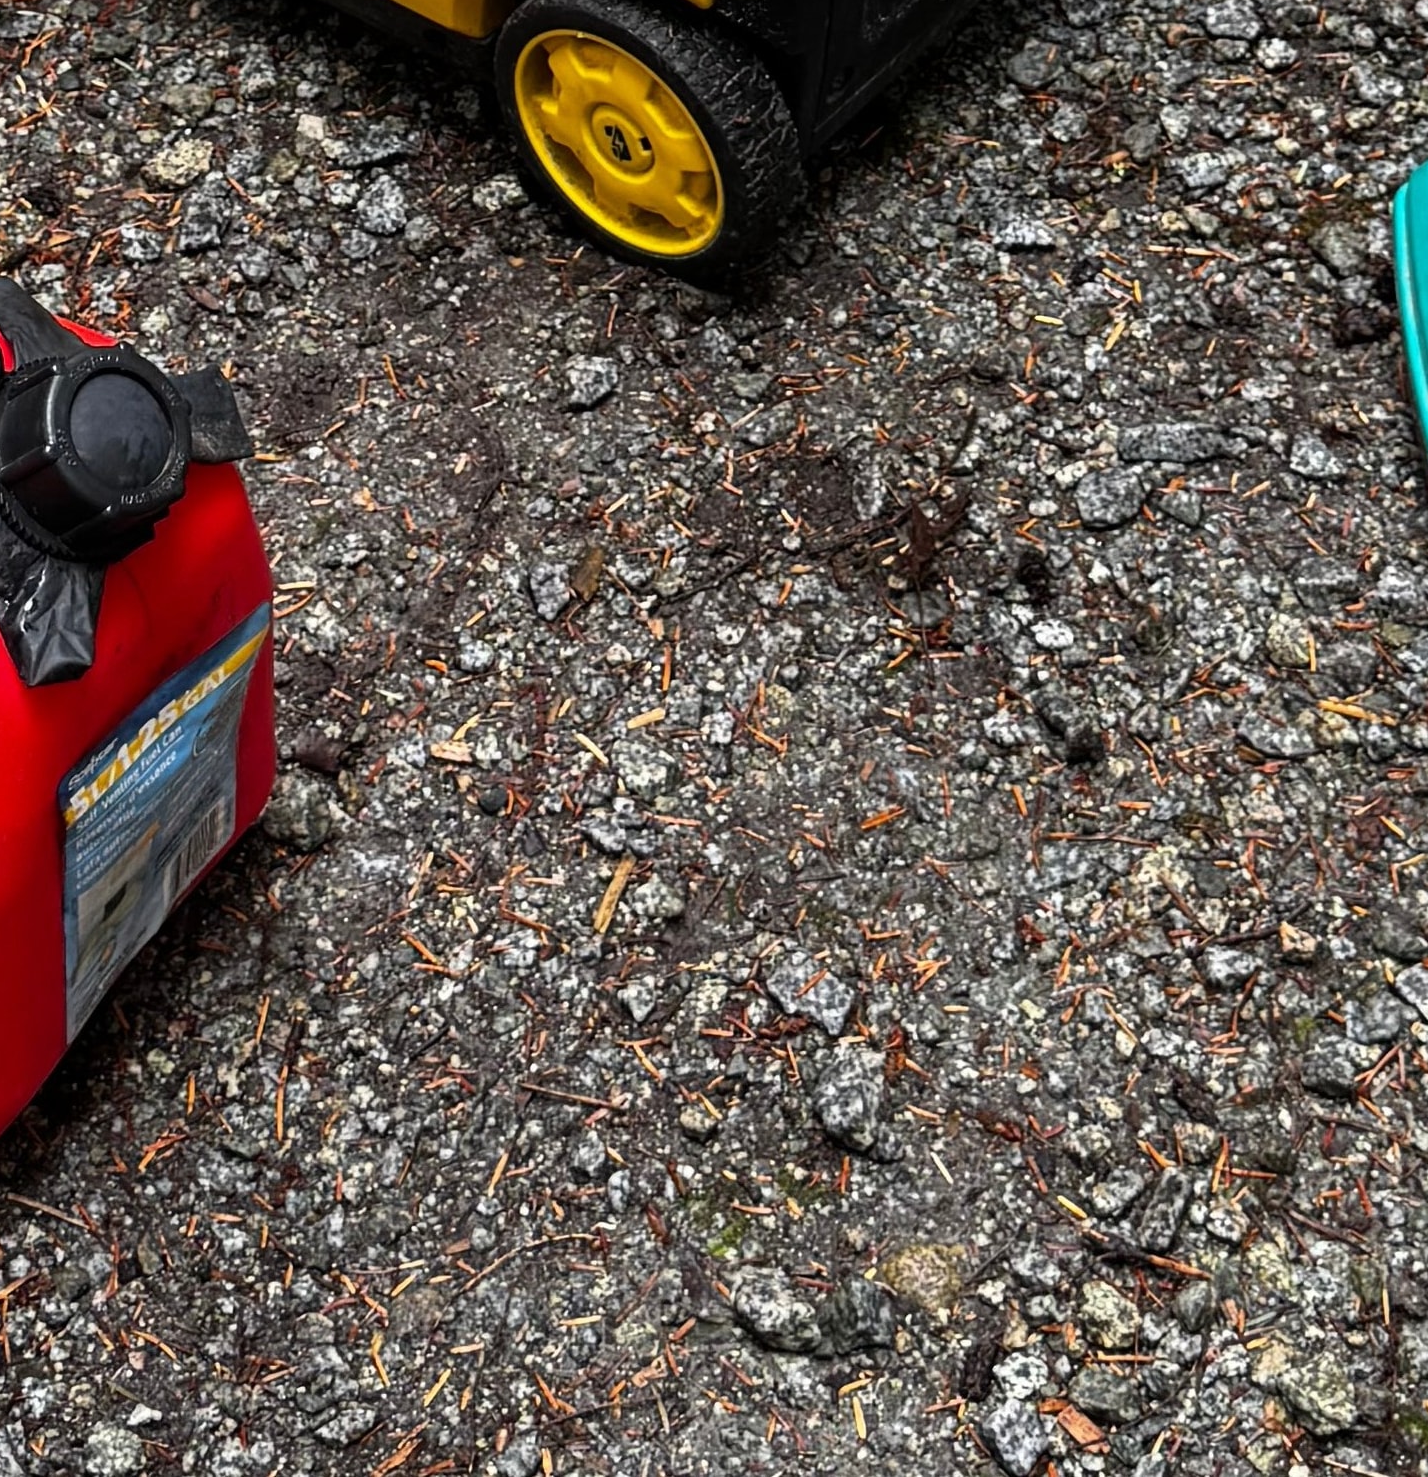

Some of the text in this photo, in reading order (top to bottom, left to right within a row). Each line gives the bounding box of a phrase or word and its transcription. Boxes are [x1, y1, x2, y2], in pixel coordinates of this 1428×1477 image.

[181, 665, 227, 715] GAL
[100, 766, 140, 809] Venting
[140, 743, 162, 773] Fuel
[162, 725, 183, 748] Can
